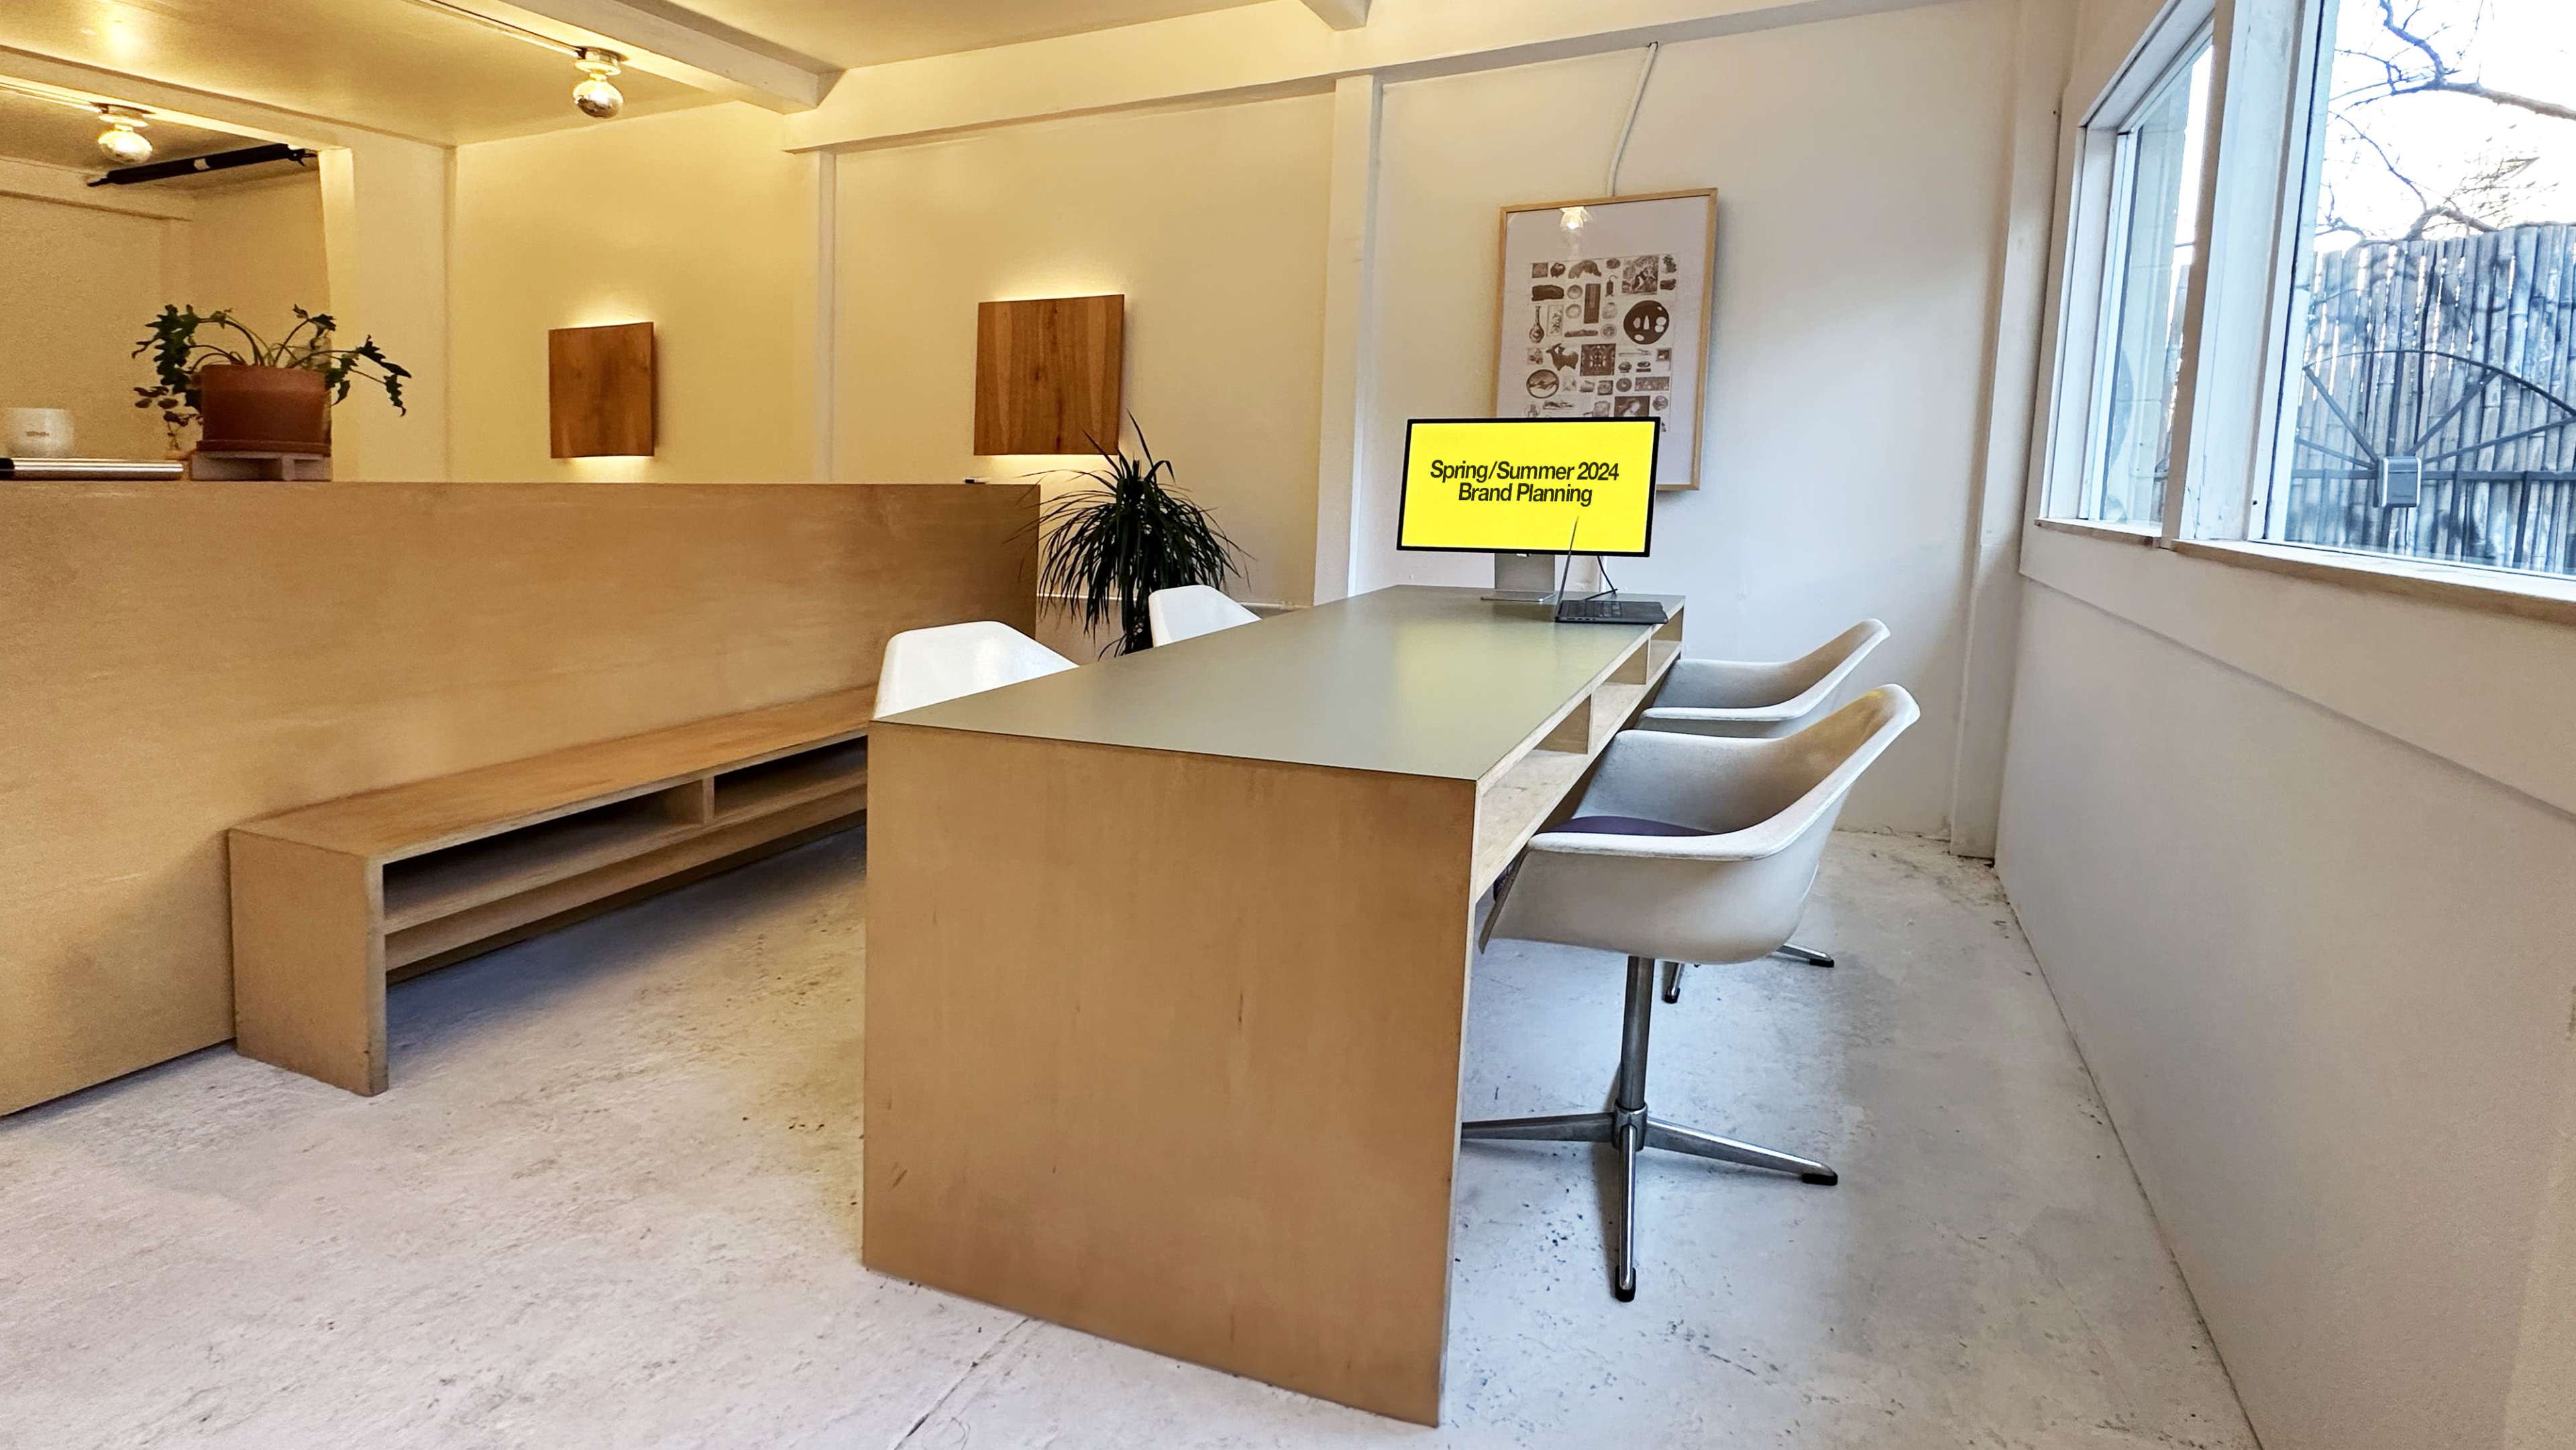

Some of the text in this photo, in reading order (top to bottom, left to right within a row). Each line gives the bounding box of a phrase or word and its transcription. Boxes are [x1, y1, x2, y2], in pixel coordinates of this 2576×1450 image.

[1430, 460, 1619, 483] Spring/Summer 2024
[1458, 482, 1593, 507] Brand Planning
